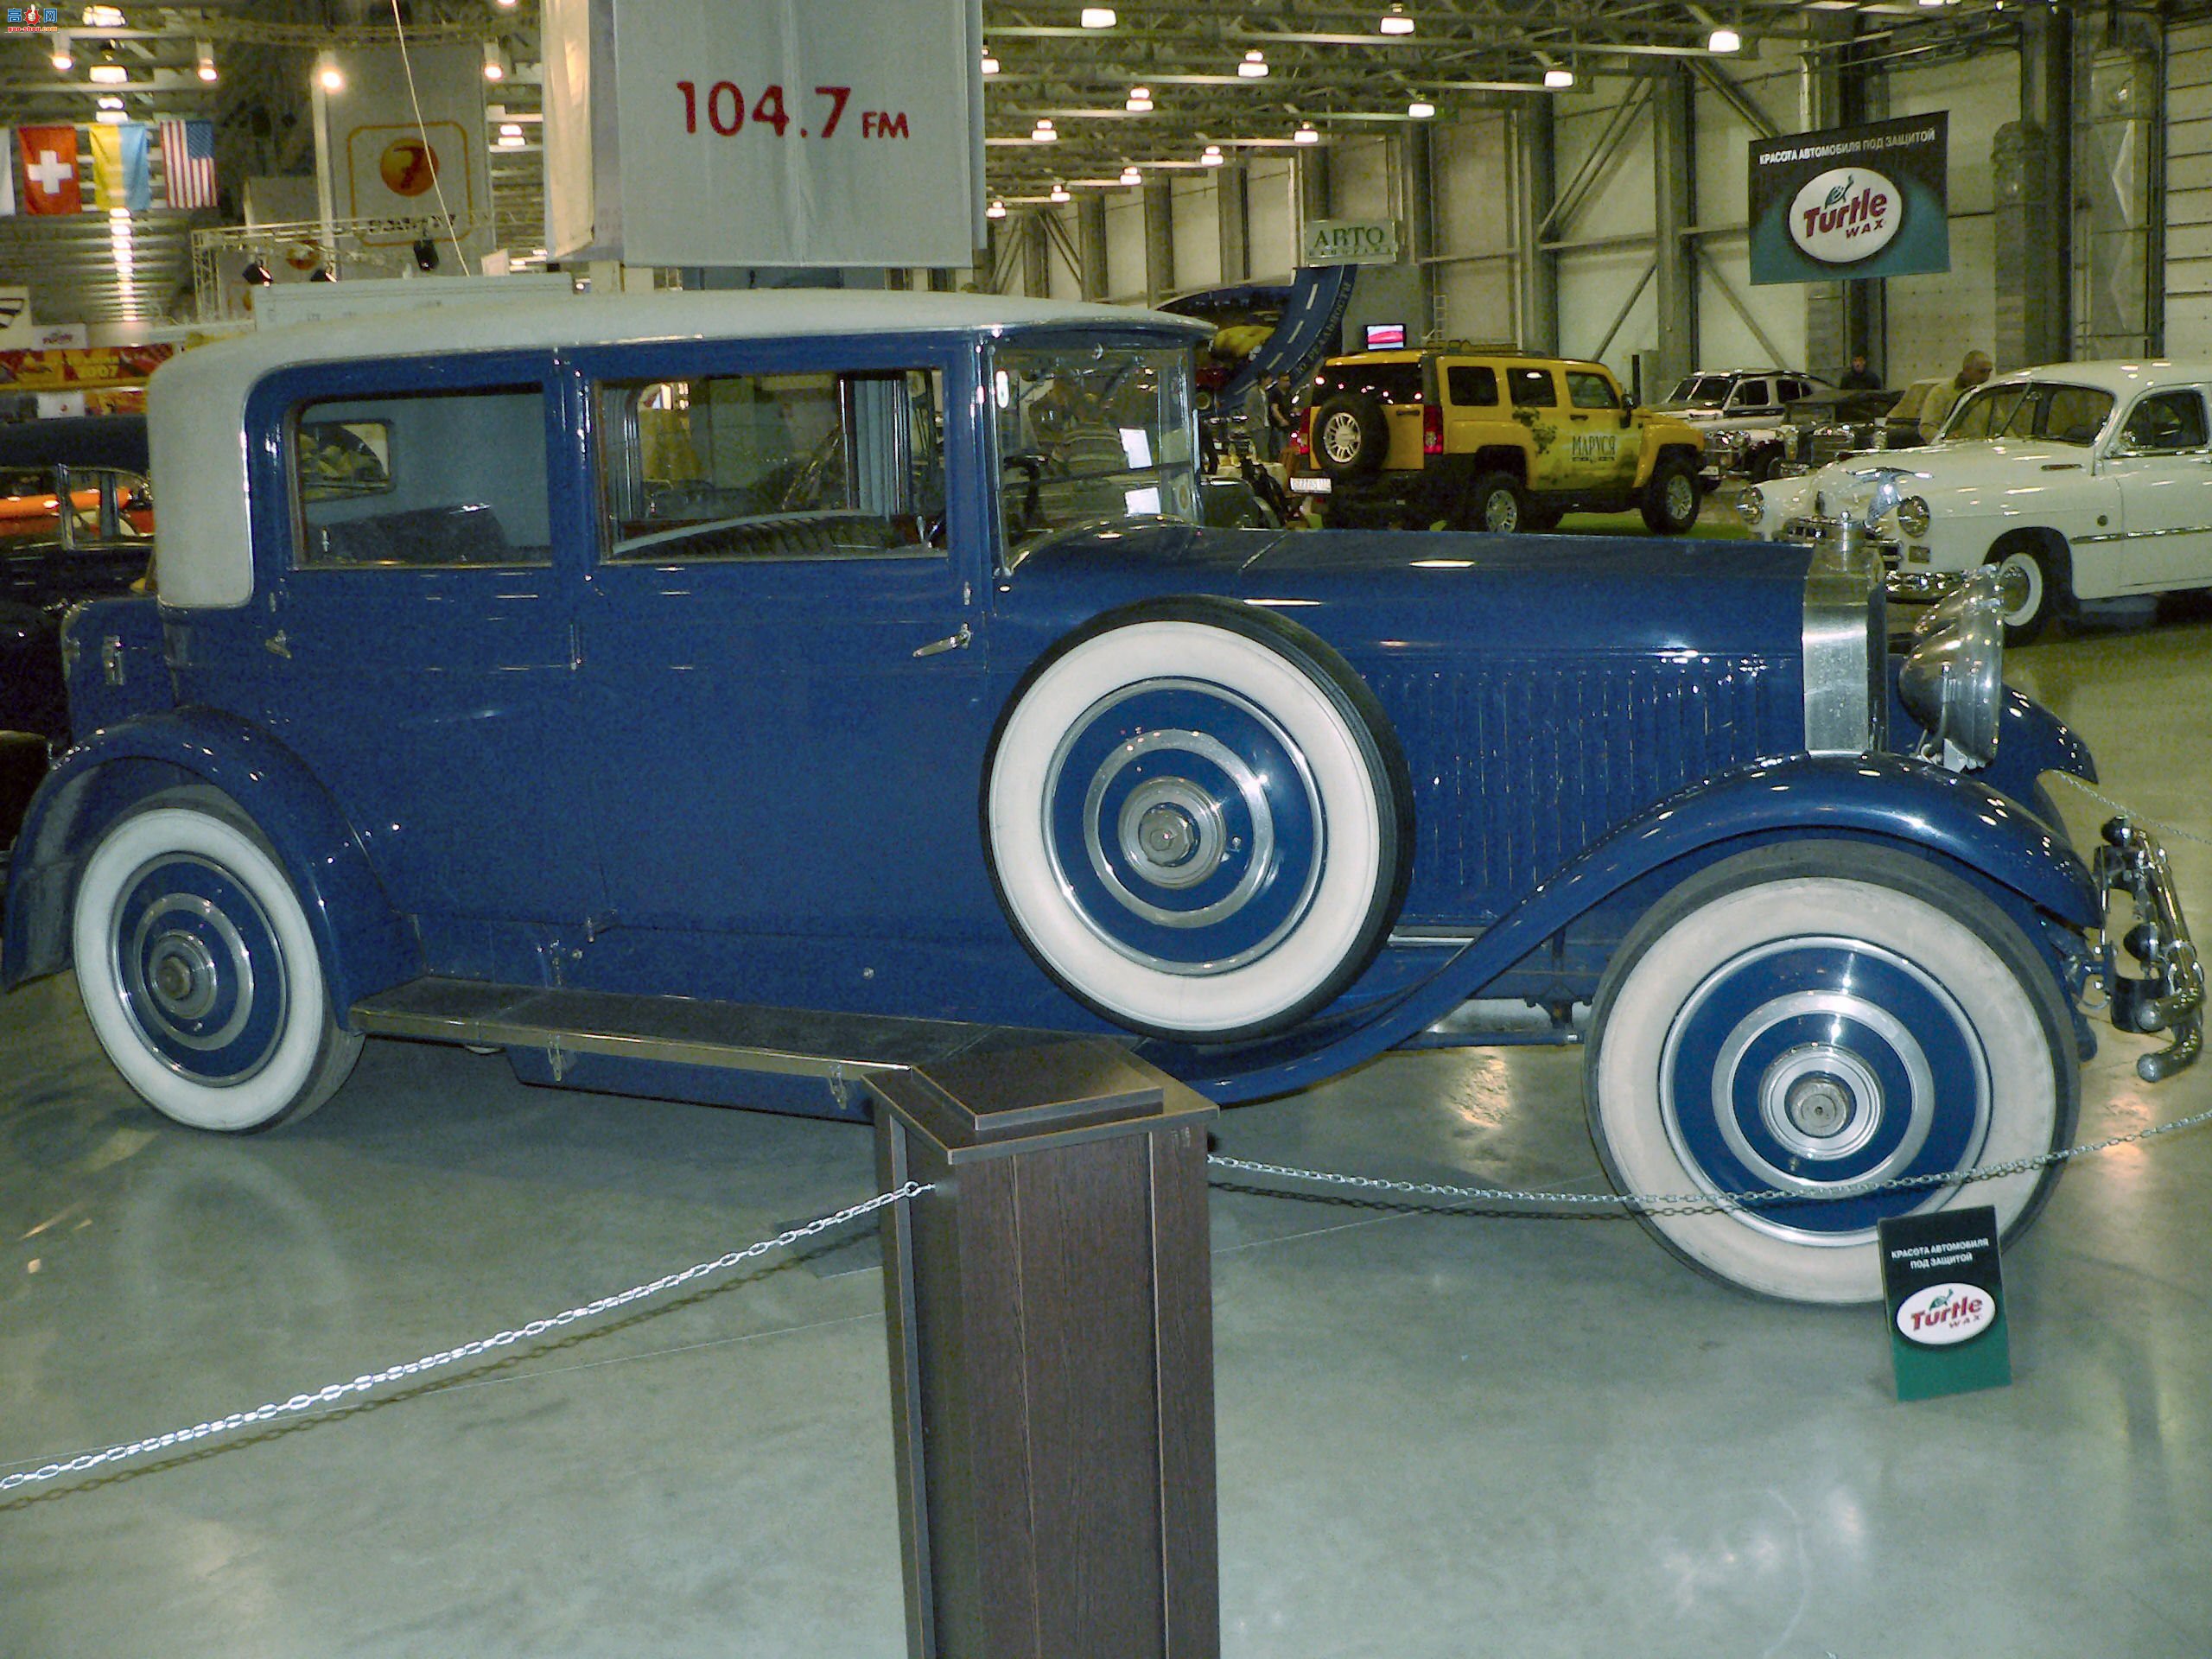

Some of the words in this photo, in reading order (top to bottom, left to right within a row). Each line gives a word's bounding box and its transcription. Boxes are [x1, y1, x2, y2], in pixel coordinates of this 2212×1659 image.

[677, 81, 851, 138] 104.7
[862, 111, 909, 139] FM
[1759, 149, 1798, 165] КРАСОТА
[1798, 141, 1861, 160] АВТОМОБИЛЯ
[1863, 138, 1885, 150] ПОД
[1885, 128, 1936, 149] ЗАЩИТОЙ
[1804, 188, 1887, 238] Turtle
[1846, 219, 1884, 238] WAX
[1572, 435, 1616, 456] МАРУСЯ
[1891, 1246, 1930, 1259] КРАСОТА
[1930, 1237, 1989, 1254] АВТОМОБИЛЯ
[1910, 1259, 1929, 1269] ПОД
[1930, 1251, 1973, 1267] ЗАЩИТОЙ
[1910, 1296, 1983, 1332] Turtle
[1948, 1315, 1982, 1329] WAX
